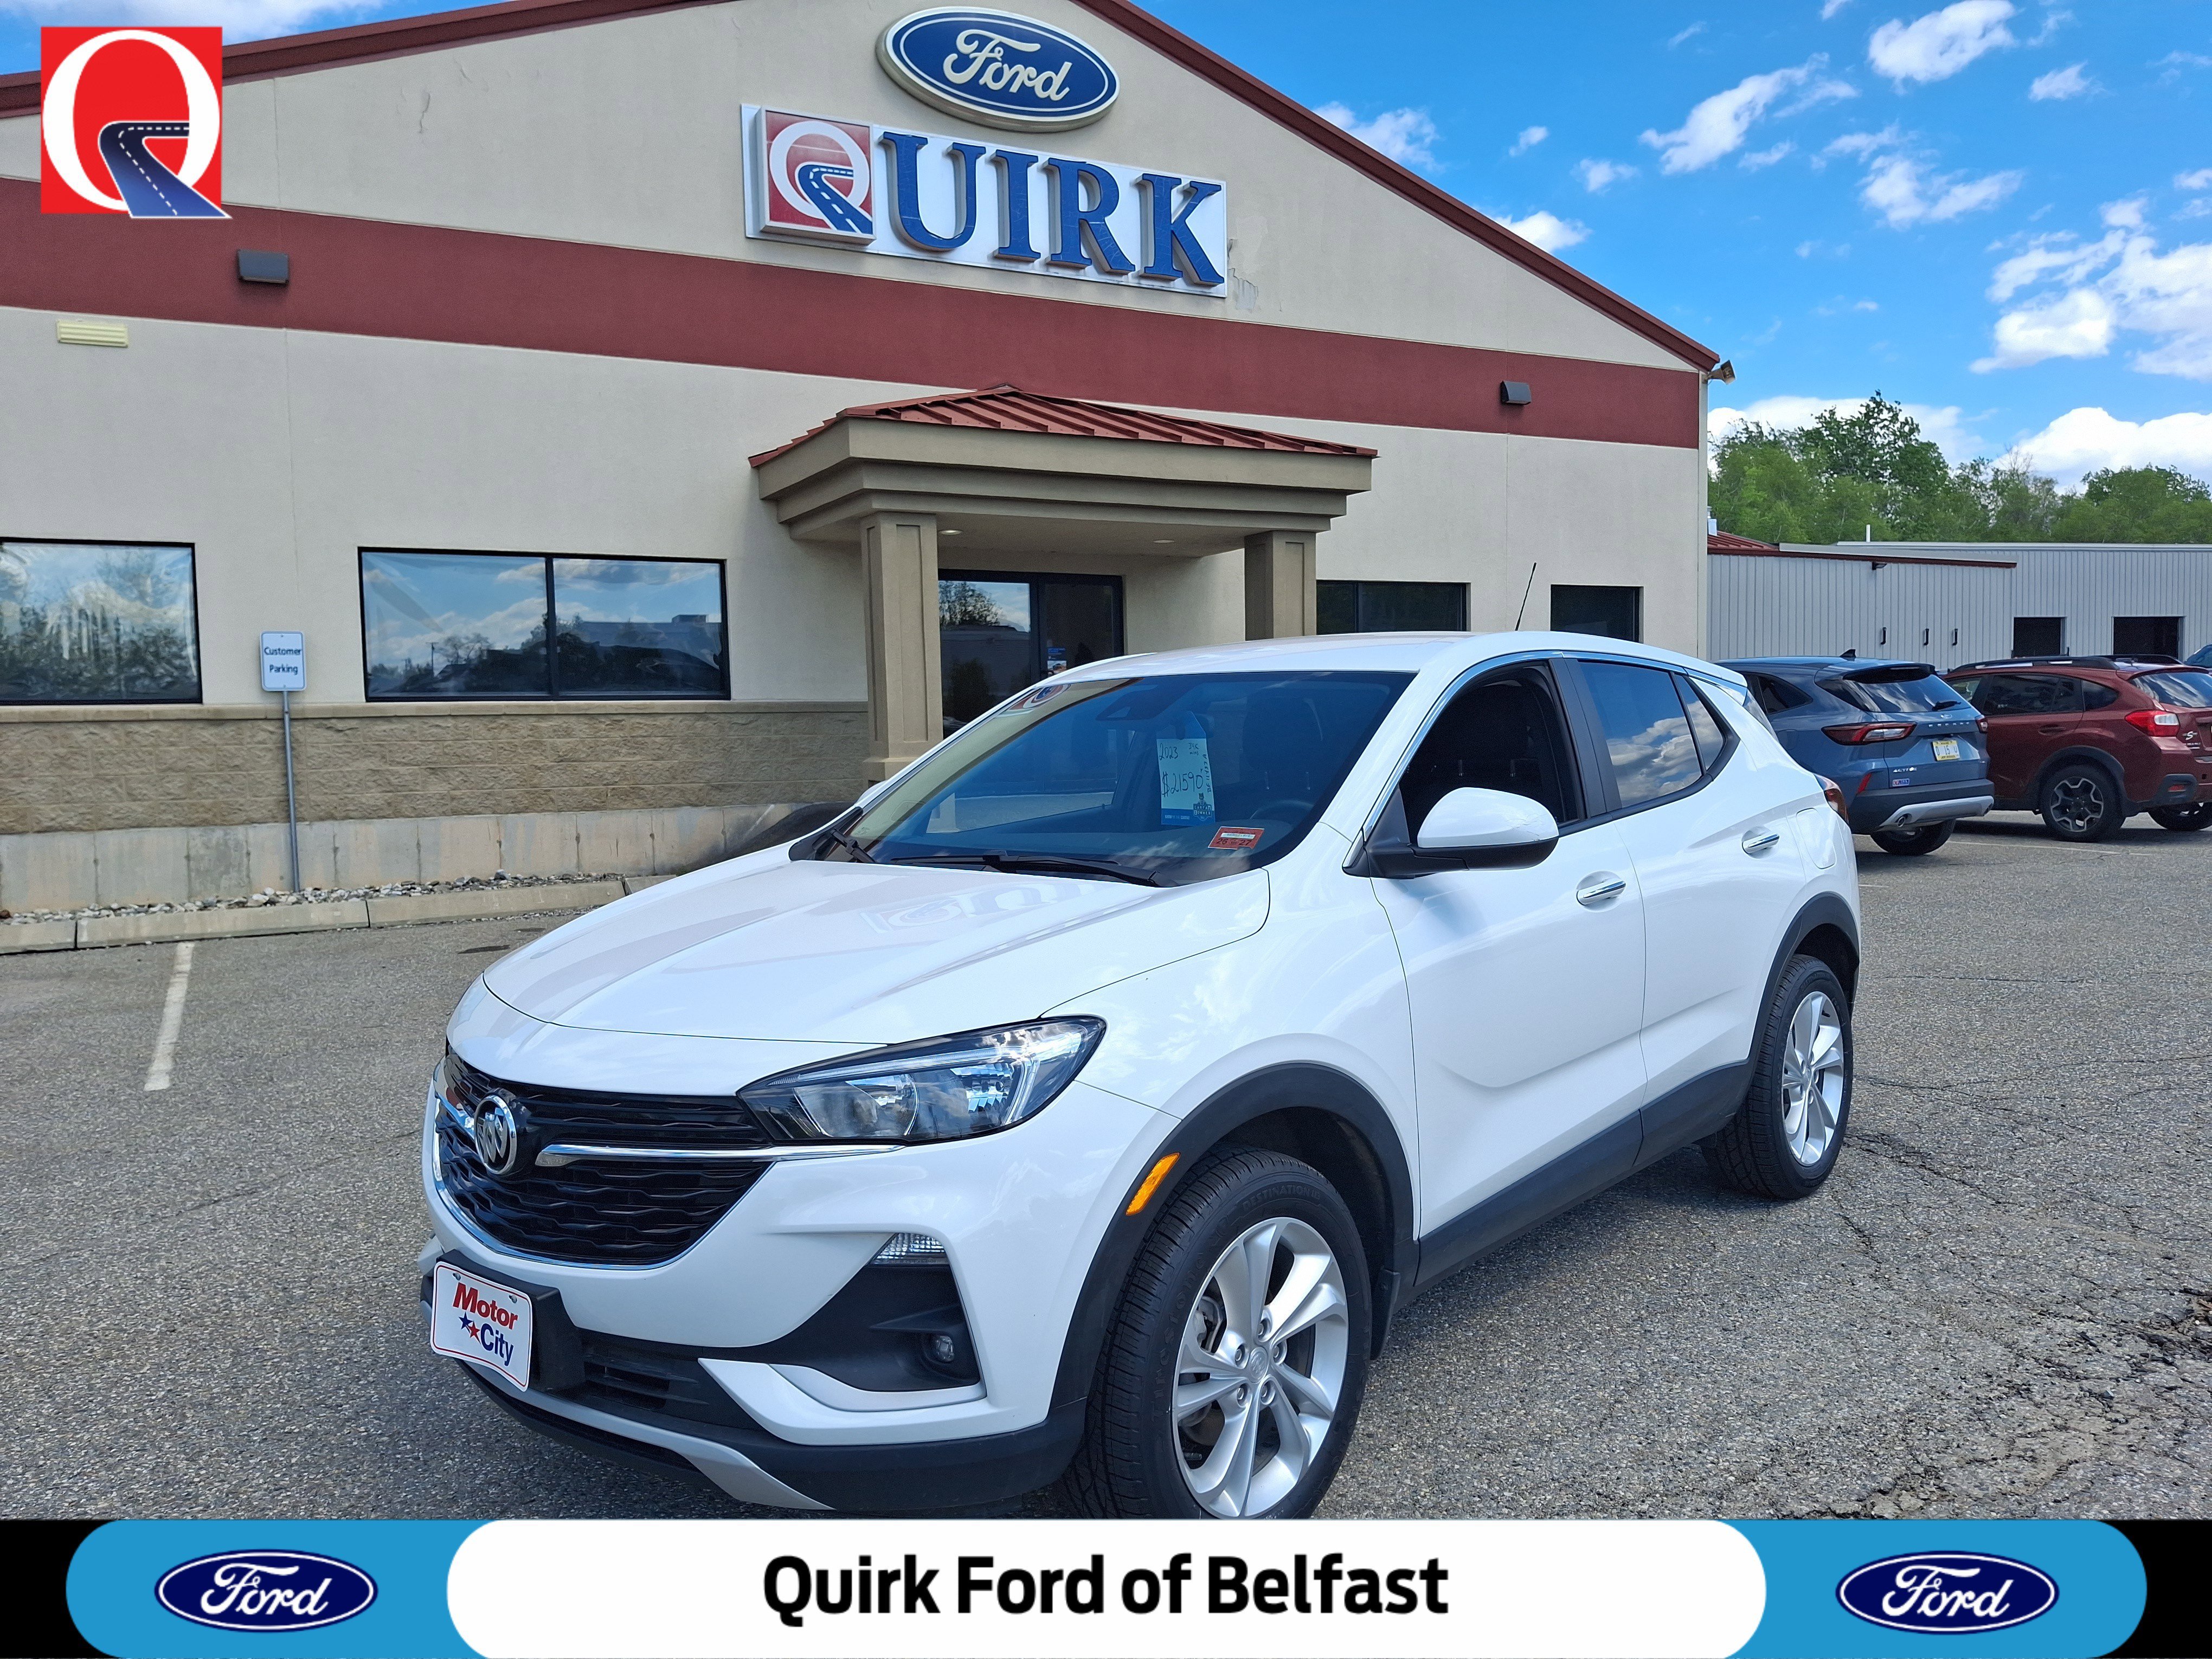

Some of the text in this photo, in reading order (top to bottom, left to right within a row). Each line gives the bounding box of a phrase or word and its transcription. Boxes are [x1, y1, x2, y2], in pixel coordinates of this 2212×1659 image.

[943, 29, 1073, 101] Ford
[768, 120, 1224, 286] QUIRK
[264, 647, 301, 655] Customer
[269, 664, 298, 676] Parking
[1159, 742, 1179, 761] 2023
[1161, 771, 1204, 797] $21590
[1242, 1185, 1310, 1210] DESTINATION
[453, 1282, 518, 1329] Motor
[480, 1323, 514, 1366] City
